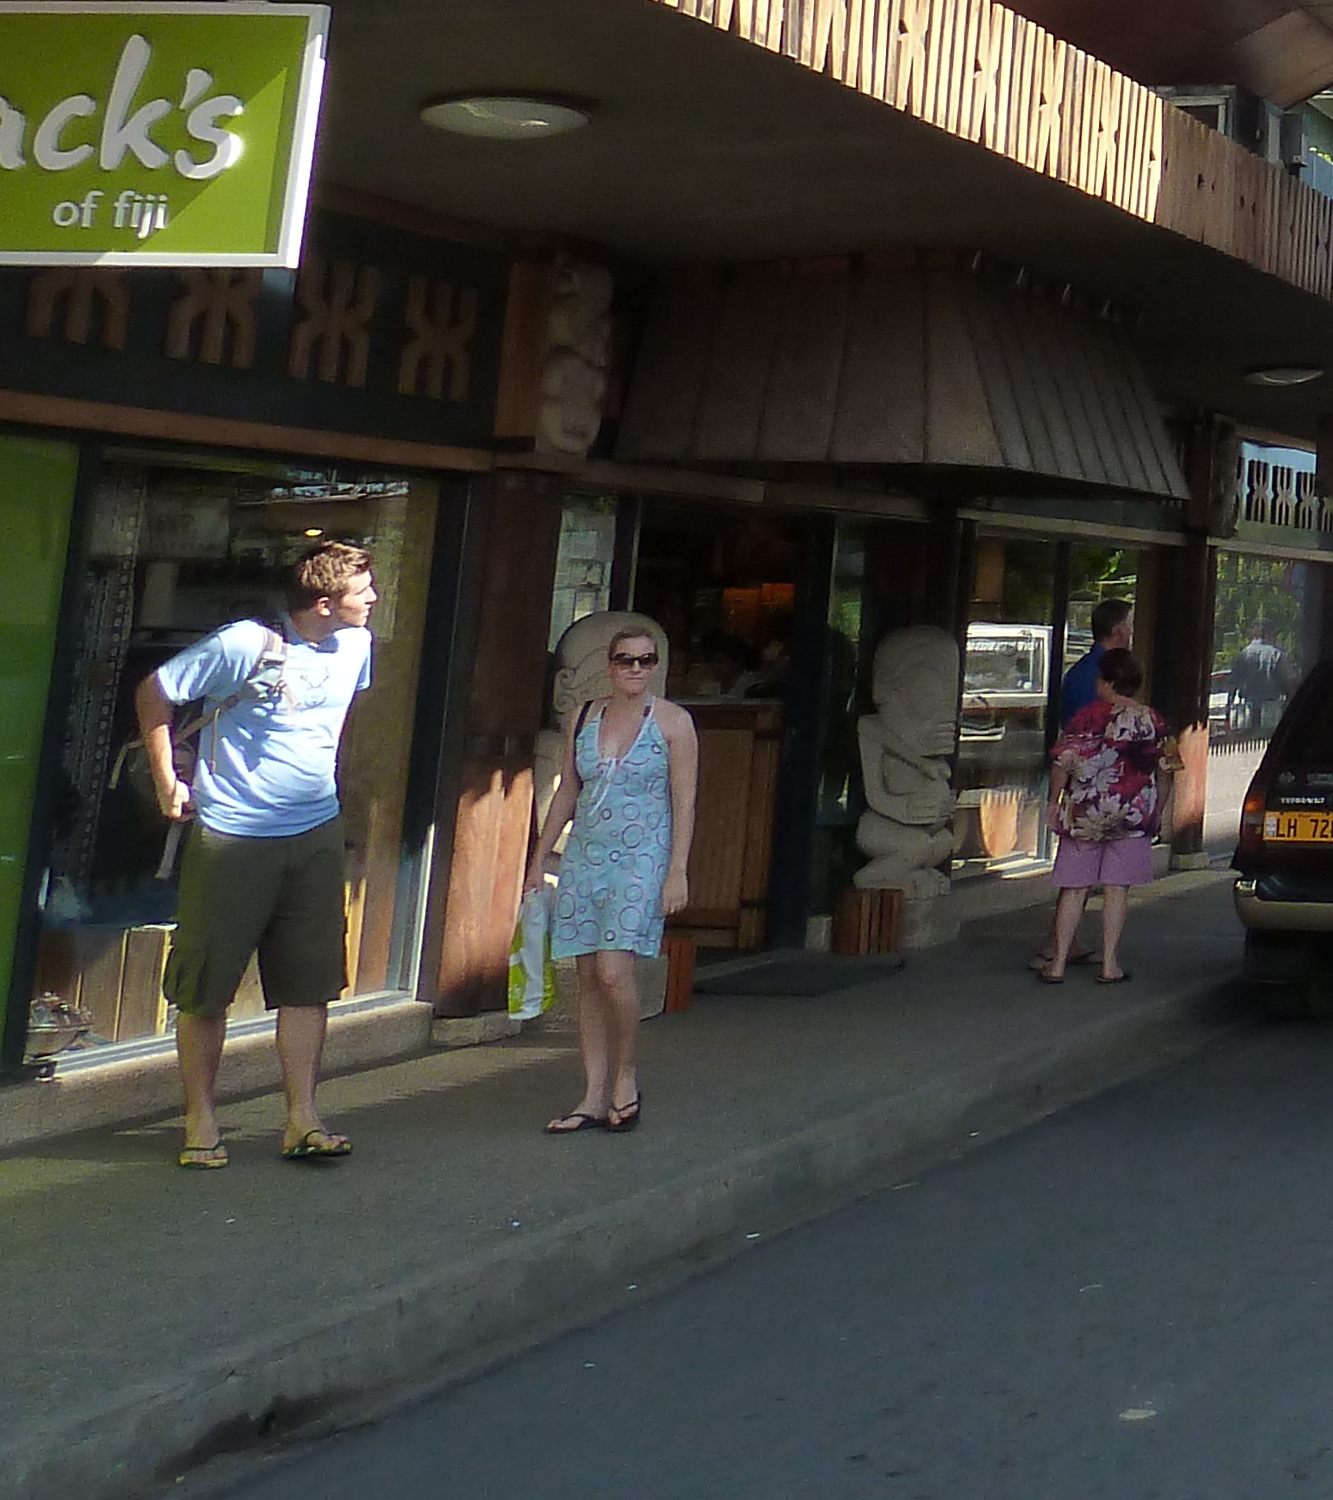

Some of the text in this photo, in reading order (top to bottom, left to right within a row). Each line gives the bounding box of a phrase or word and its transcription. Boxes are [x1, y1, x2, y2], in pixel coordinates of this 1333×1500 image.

[53, 190, 169, 239] of fiji
[1276, 818, 1298, 838] LH
